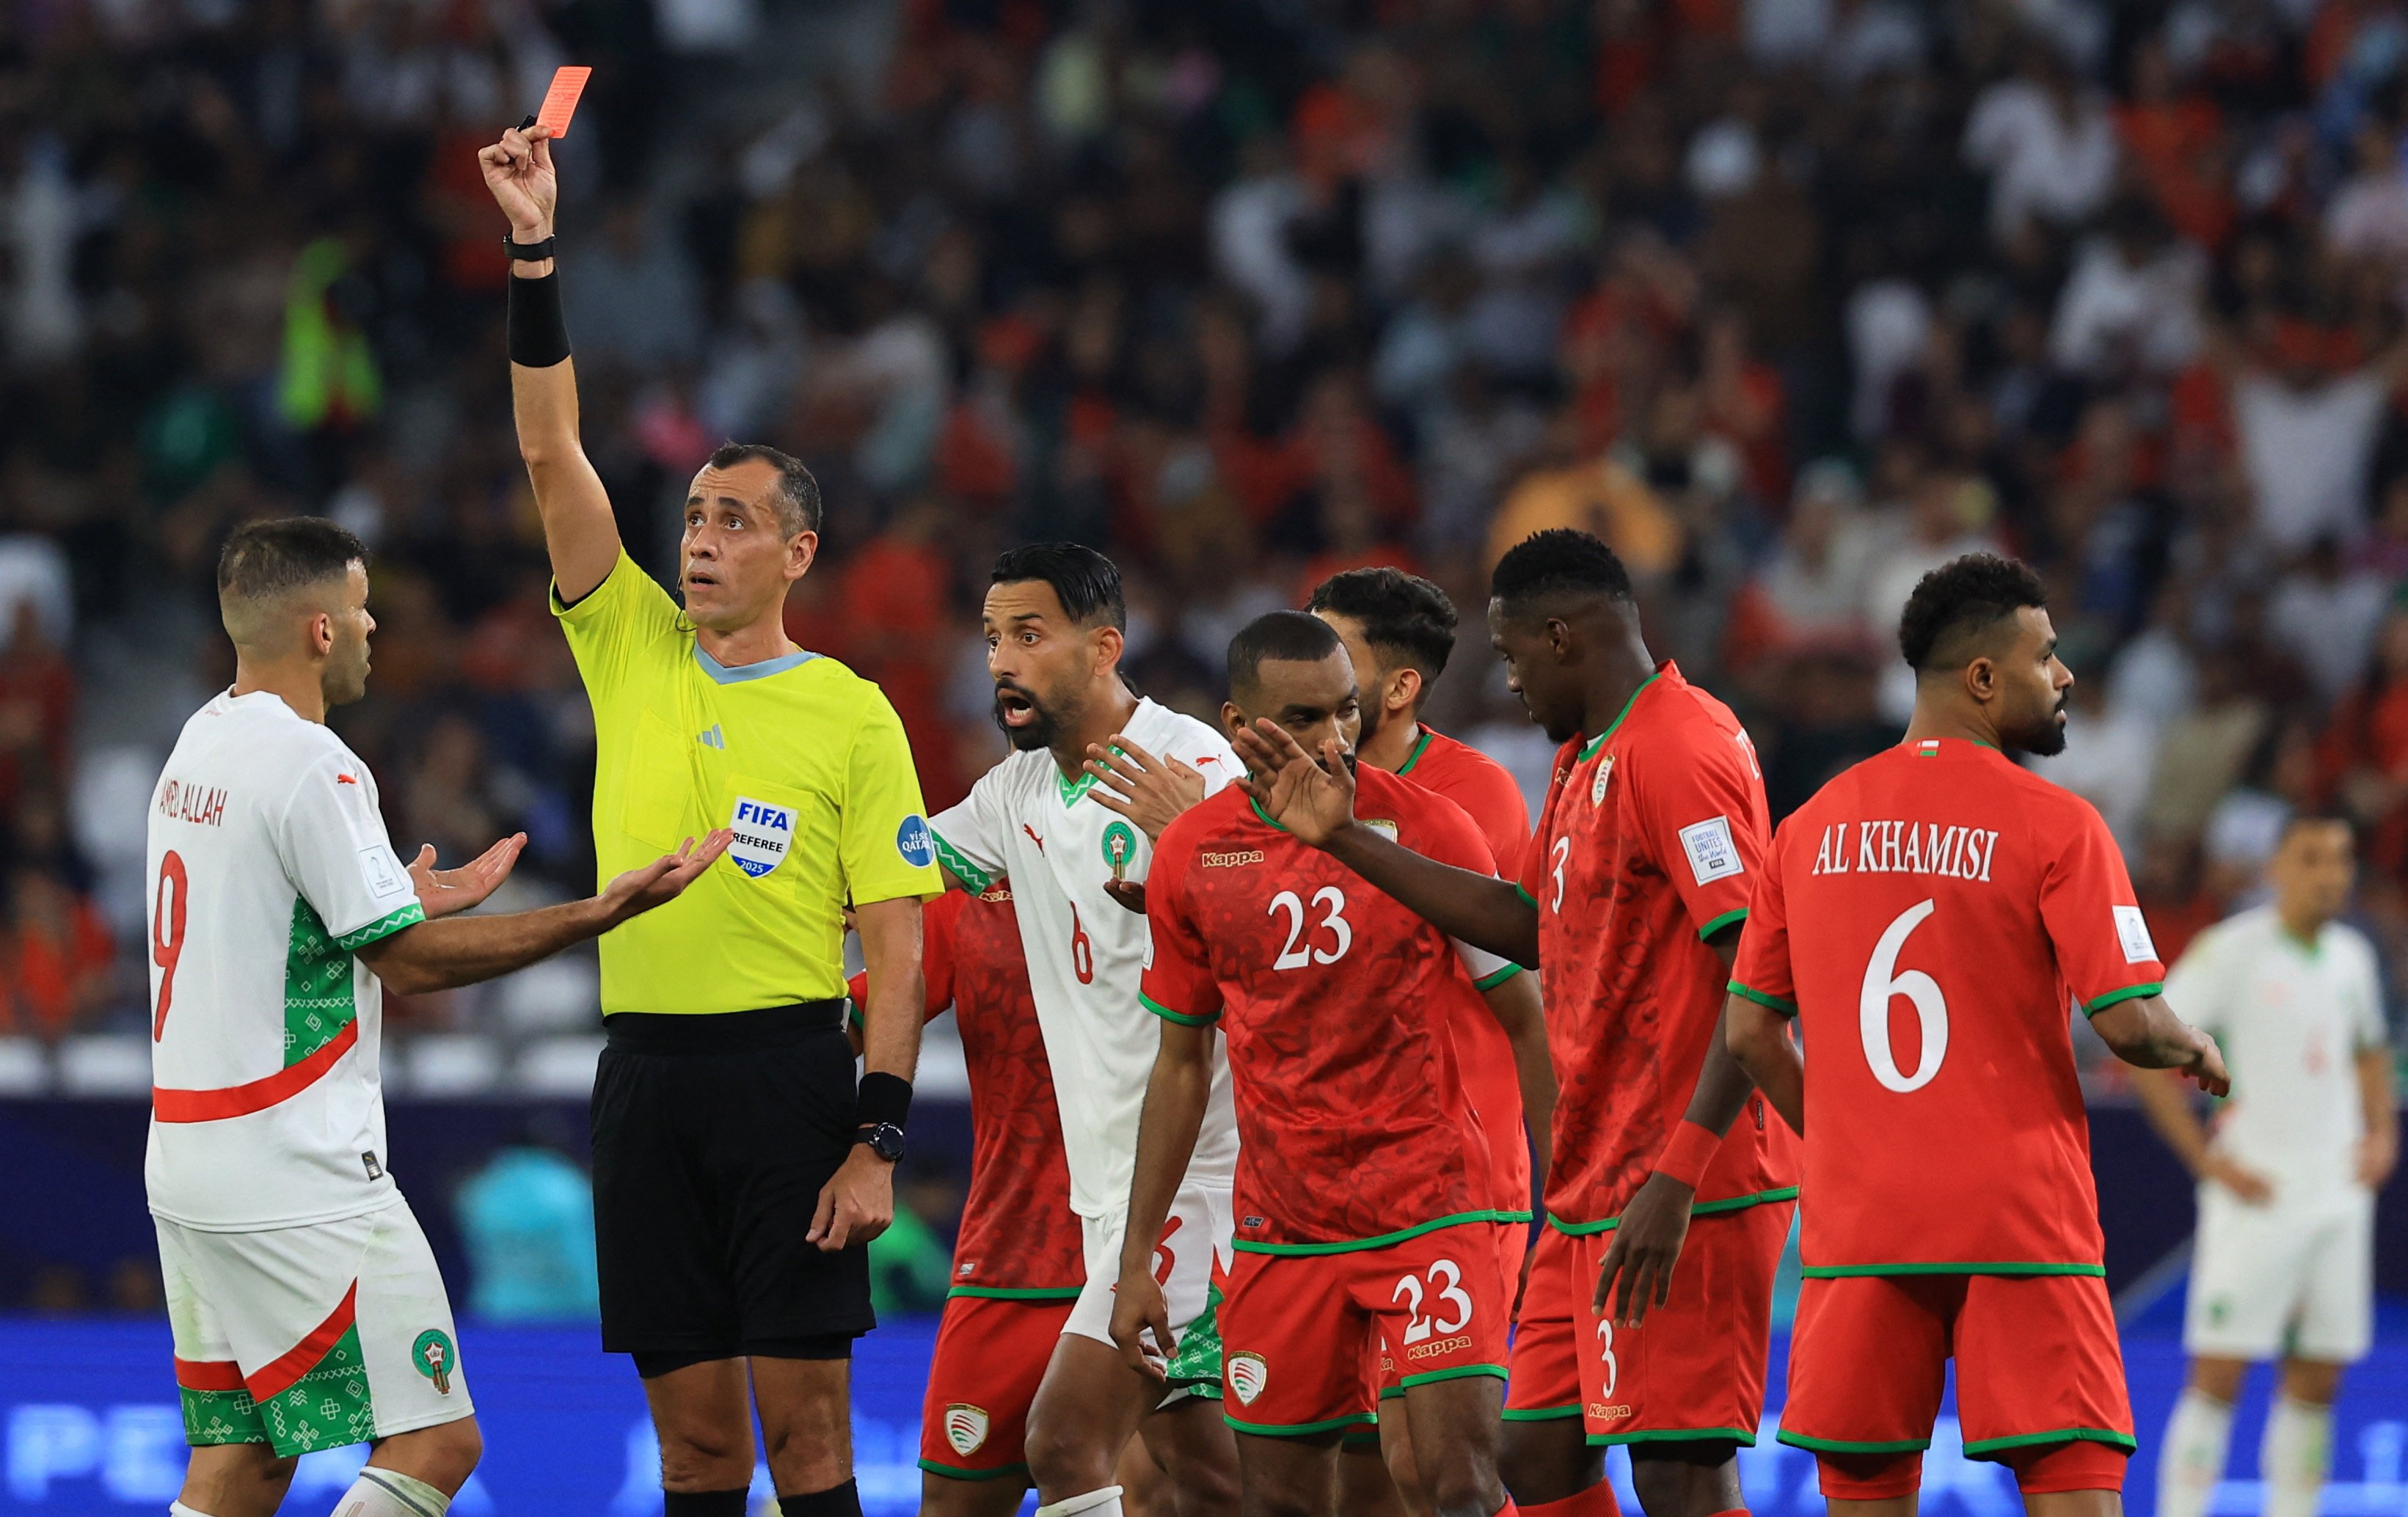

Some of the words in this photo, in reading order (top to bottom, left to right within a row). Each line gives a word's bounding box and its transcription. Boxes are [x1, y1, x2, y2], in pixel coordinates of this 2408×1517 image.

[181, 783, 227, 827] ALLAH
[737, 802, 788, 831] FIFA
[733, 832, 784, 852] REFEREE
[902, 840, 930, 852] QATAR
[1692, 830, 1719, 842] FOOTBALL
[1695, 836, 1723, 852] UNITES
[1812, 822, 1850, 876] AL
[1856, 820, 1999, 882] KHAMISI
[740, 860, 764, 874] 2025
[1202, 850, 1264, 867] Kappa
[1552, 836, 1570, 915] 3
[153, 849, 188, 1042] 9
[1070, 900, 1093, 984] 6
[1268, 885, 1353, 971] 23
[1859, 897, 1949, 1093] 6
[1392, 1259, 1472, 1345] 23
[1408, 1336, 1472, 1360] Kappa
[1597, 1319, 1617, 1399] 3
[1588, 1403, 1632, 1421] Kappa
